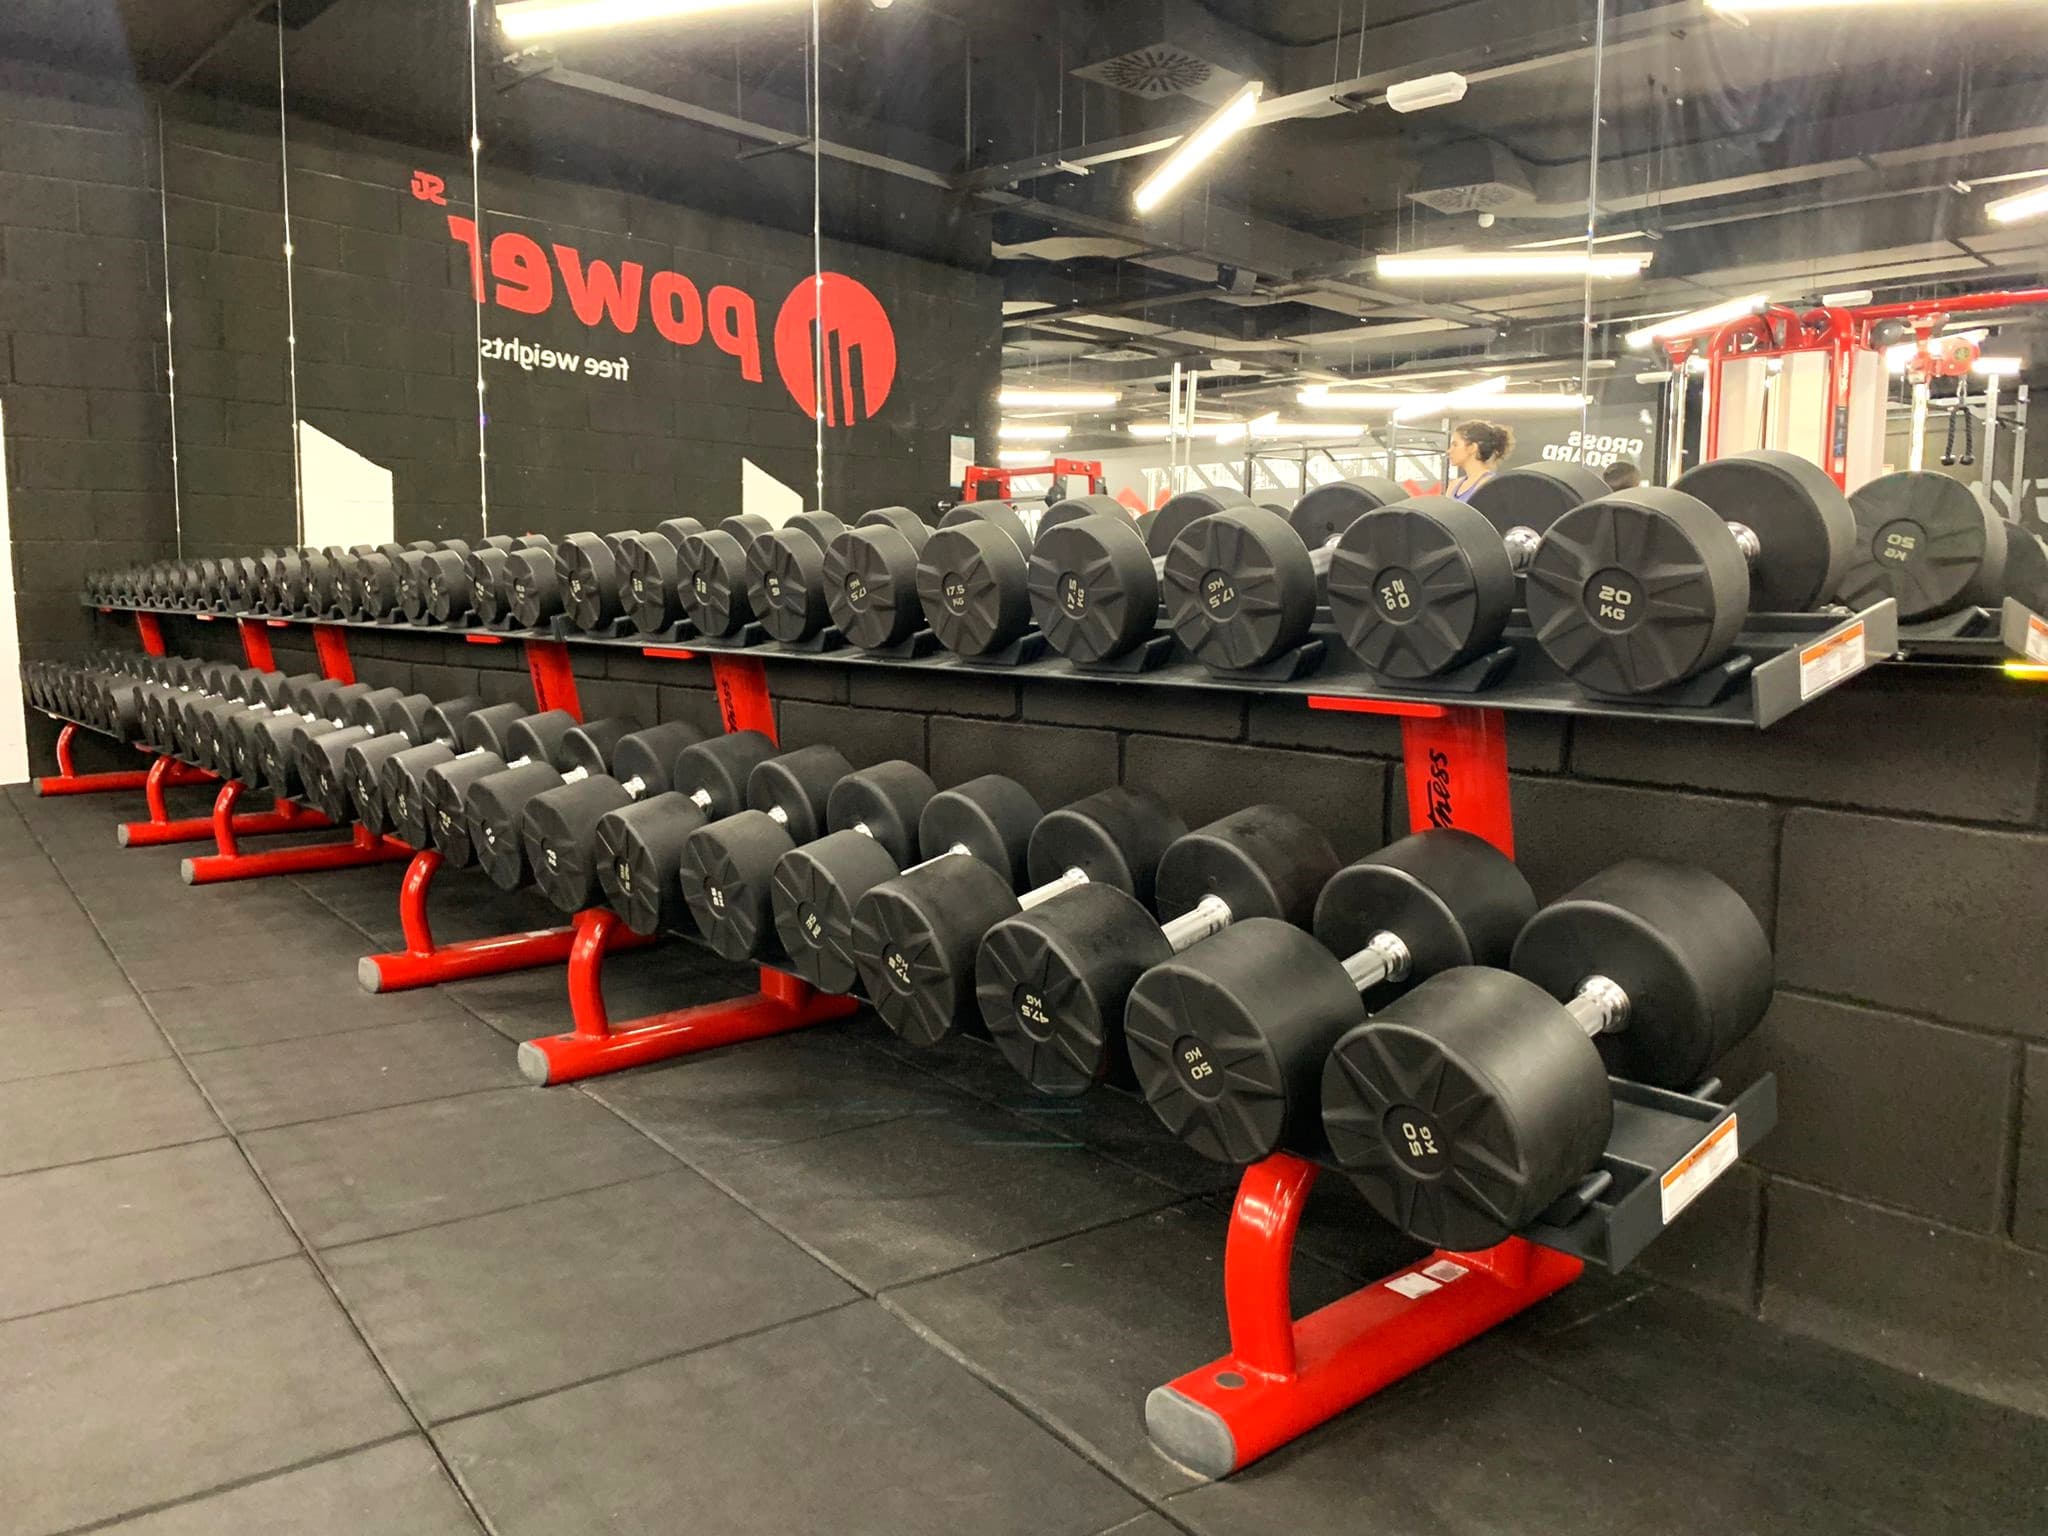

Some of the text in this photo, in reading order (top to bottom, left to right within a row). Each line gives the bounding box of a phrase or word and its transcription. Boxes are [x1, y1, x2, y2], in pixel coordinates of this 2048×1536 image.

[945, 584, 966, 597] 17.5
[1208, 576, 1225, 592] KG
[1391, 578, 1411, 610] 20
[1208, 587, 1235, 609] 17.5
[1380, 586, 1397, 611] KG
[1599, 585, 1632, 606] 20
[1600, 604, 1626, 621] KG
[1025, 994, 1042, 1008] KG
[1021, 1004, 1050, 1025] 47.5
[1184, 1046, 1203, 1063] KG
[1190, 1061, 1214, 1080] 50
[1402, 1122, 1424, 1157] 50
[1419, 1126, 1439, 1155] KG
